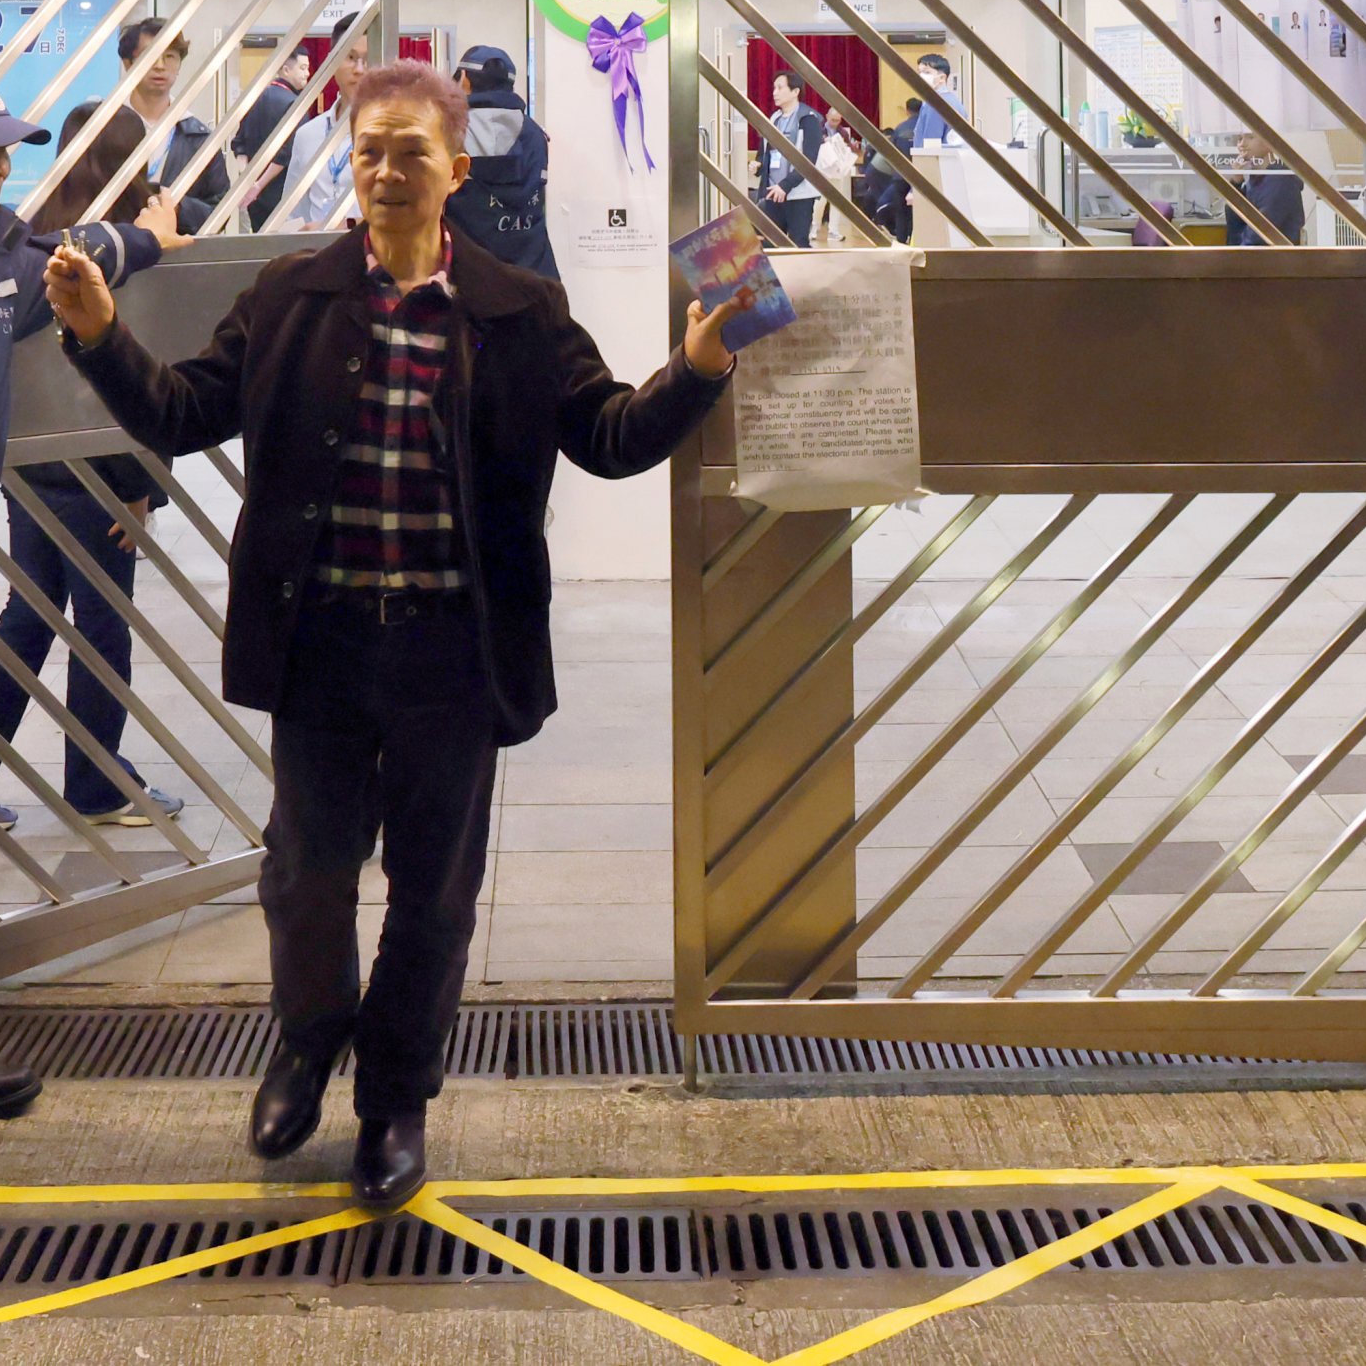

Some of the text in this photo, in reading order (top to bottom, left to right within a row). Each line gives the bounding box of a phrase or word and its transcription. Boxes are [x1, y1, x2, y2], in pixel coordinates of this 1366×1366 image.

[821, 4, 874, 12] ENCE
[323, 10, 344, 18] EXIT
[497, 215, 533, 232] CAS
[858, 387, 872, 395] The
[875, 387, 901, 395] station
[820, 399, 852, 408] counting
[765, 422, 788, 431] public
